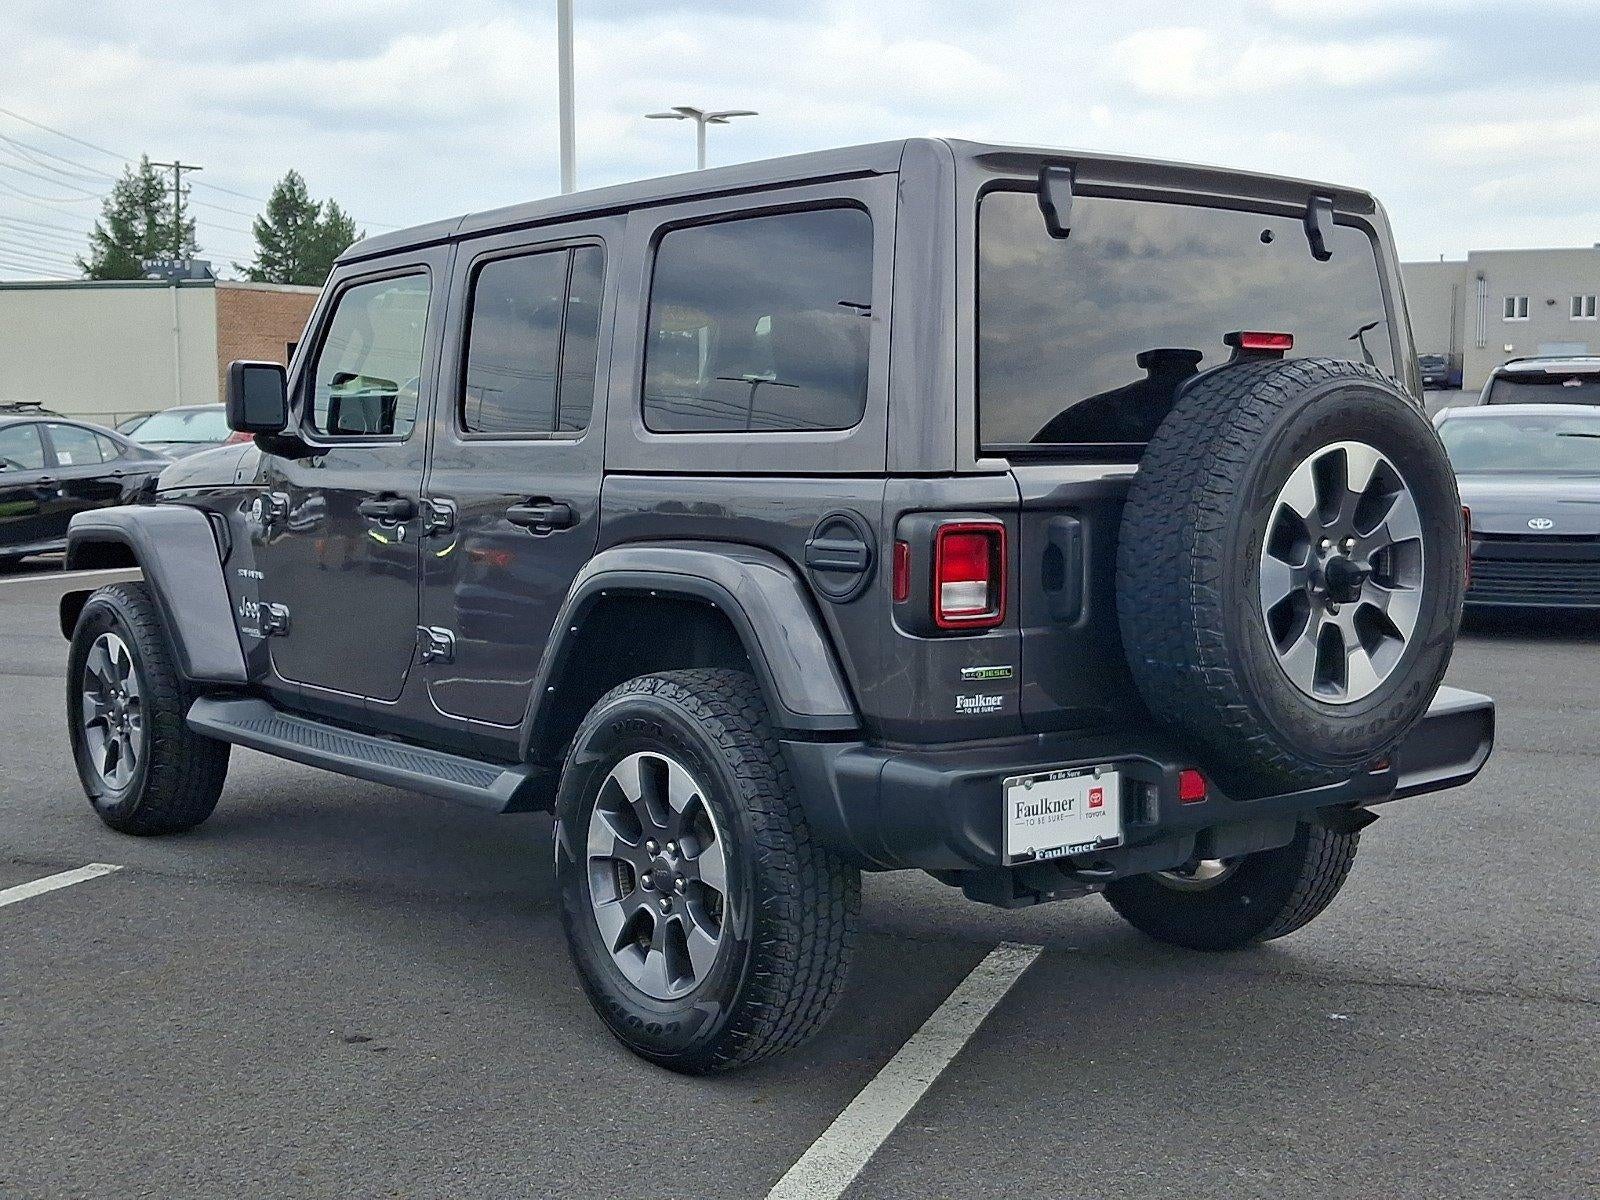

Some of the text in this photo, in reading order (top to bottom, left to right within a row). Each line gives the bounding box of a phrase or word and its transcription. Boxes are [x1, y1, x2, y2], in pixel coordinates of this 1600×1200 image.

[955, 694, 1003, 708] Faulkner
[1015, 798, 1075, 820] Faulkner
[1085, 811, 1106, 819] TOYOTA
[1048, 814, 1064, 823] SURE
[1035, 842, 1098, 860] Faulkner
